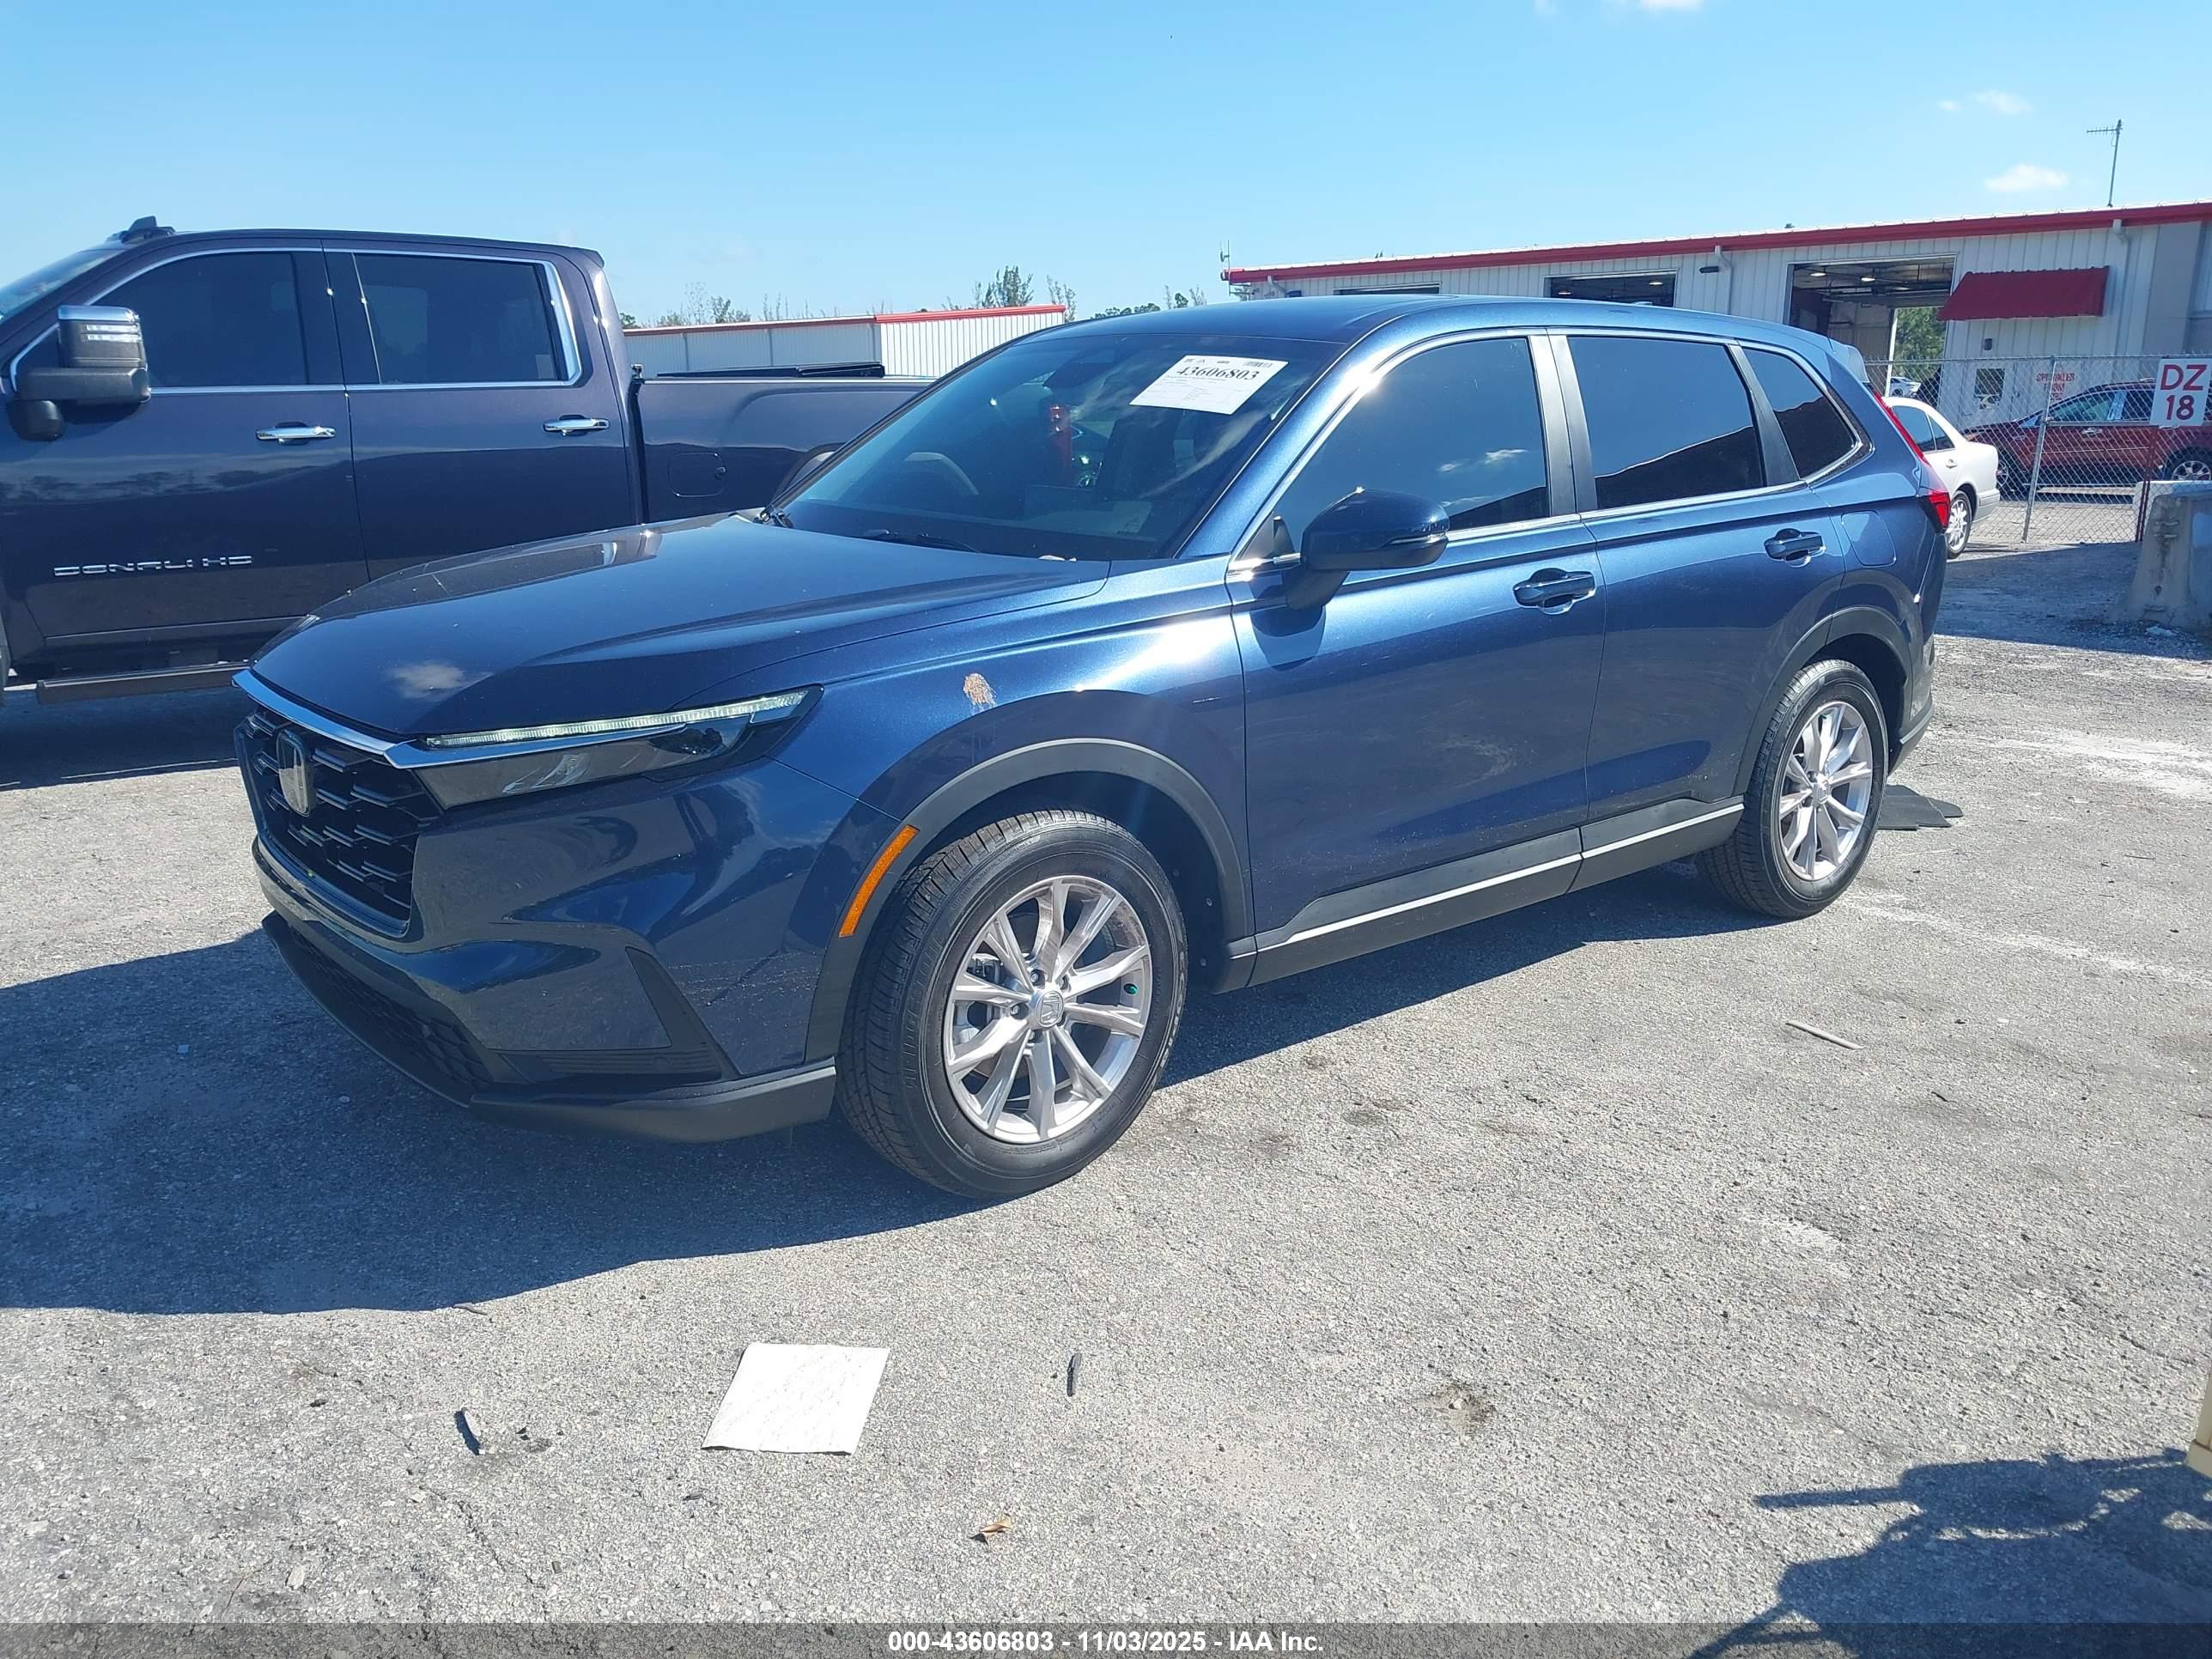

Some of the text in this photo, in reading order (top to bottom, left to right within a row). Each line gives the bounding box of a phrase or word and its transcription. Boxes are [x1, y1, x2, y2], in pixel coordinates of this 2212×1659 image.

[1176, 366, 1261, 380] 43606803
[2160, 364, 2208, 391] DZ
[2166, 395, 2195, 421] 18
